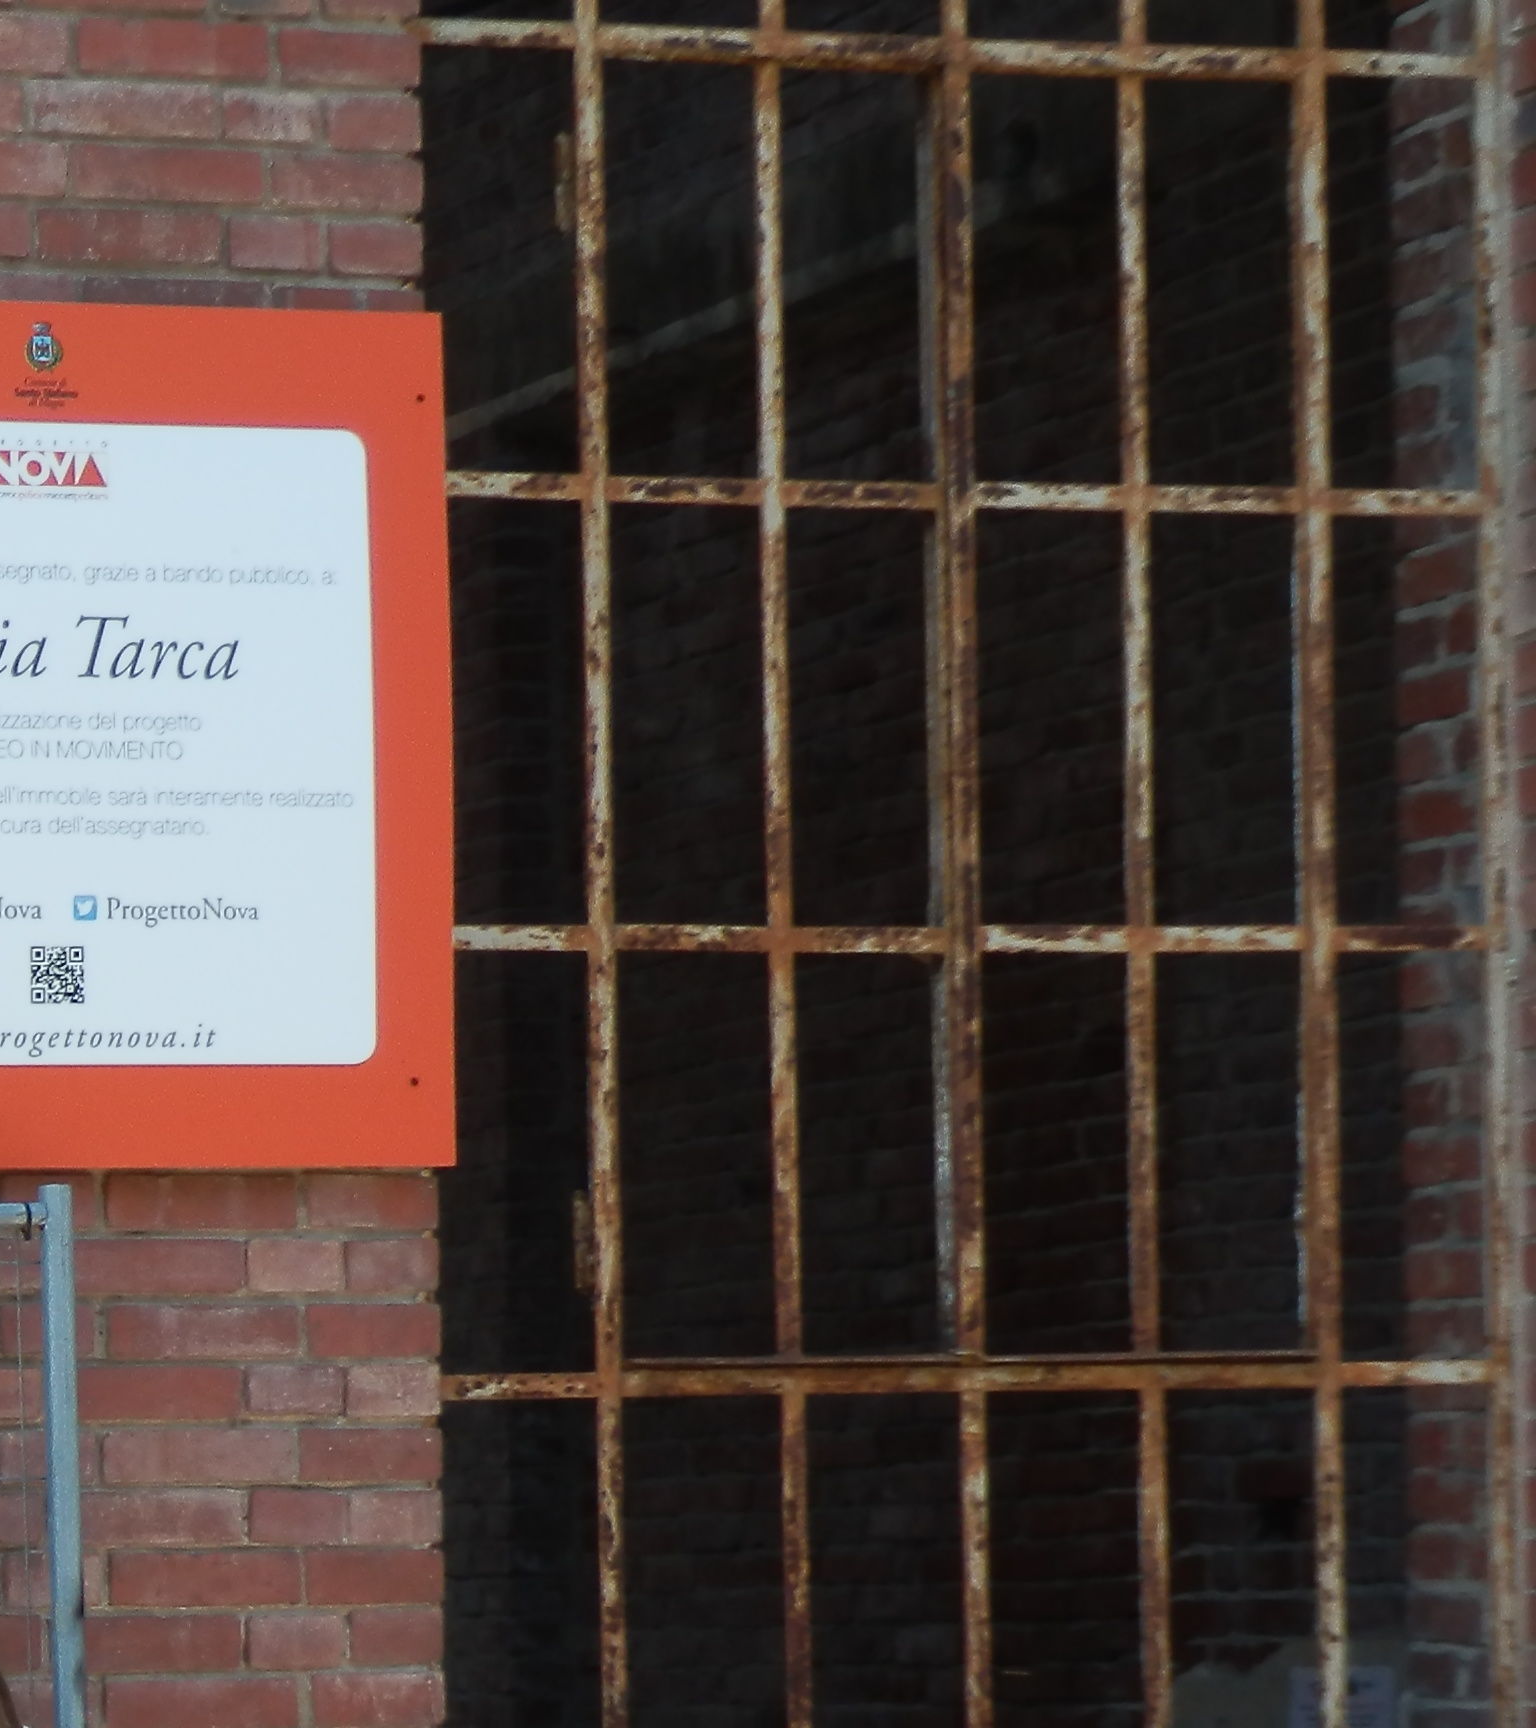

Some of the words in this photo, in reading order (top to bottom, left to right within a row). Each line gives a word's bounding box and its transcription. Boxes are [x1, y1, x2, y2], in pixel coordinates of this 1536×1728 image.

[82, 564, 140, 587] grazie
[144, 566, 157, 583] a
[162, 563, 224, 584] bando
[228, 564, 315, 587] pubblico,
[74, 614, 240, 681] Tarca
[87, 712, 117, 731] del
[122, 713, 203, 736] progetto
[30, 739, 50, 759] IN
[56, 740, 184, 761] MOVIMENTO
[106, 787, 148, 807] sarà
[154, 787, 264, 808] interamente
[268, 788, 354, 808] realizzato
[0, 818, 42, 834] cura
[105, 897, 260, 929] ProgettoNova
